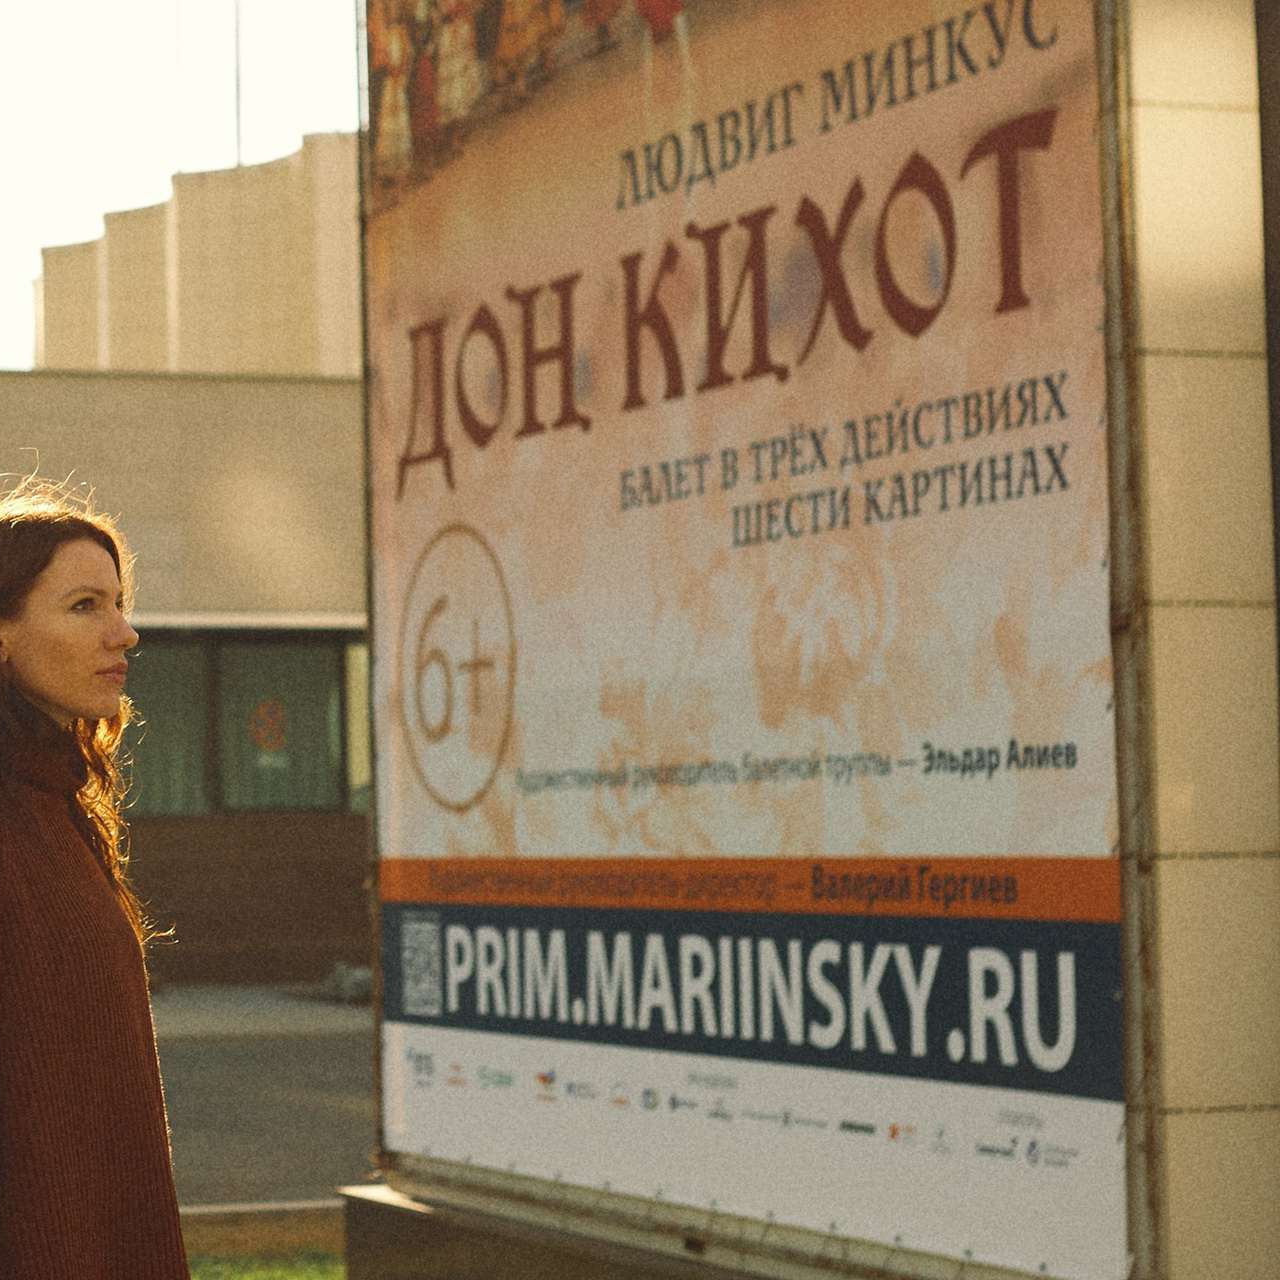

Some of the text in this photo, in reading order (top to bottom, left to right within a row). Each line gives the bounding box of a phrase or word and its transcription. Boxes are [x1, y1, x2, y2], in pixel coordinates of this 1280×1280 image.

[615, 83, 804, 210] ЛЮДВИГ
[396, 107, 1059, 502] ДОН КИХОТ
[620, 372, 1069, 511] БАЛЕТ В ТРЁХ ДЕЙСТВИЯХ
[732, 442, 1070, 548] ШЕСТИ КАРТИНАХ
[415, 594, 495, 744] 6+
[923, 740, 1000, 780] Эльдар
[1007, 738, 1078, 770] Алиев
[811, 865, 912, 907] Валерий
[918, 865, 1018, 911] Гергиев
[445, 925, 1078, 1072] PRIM.MARIINSKY.RU
